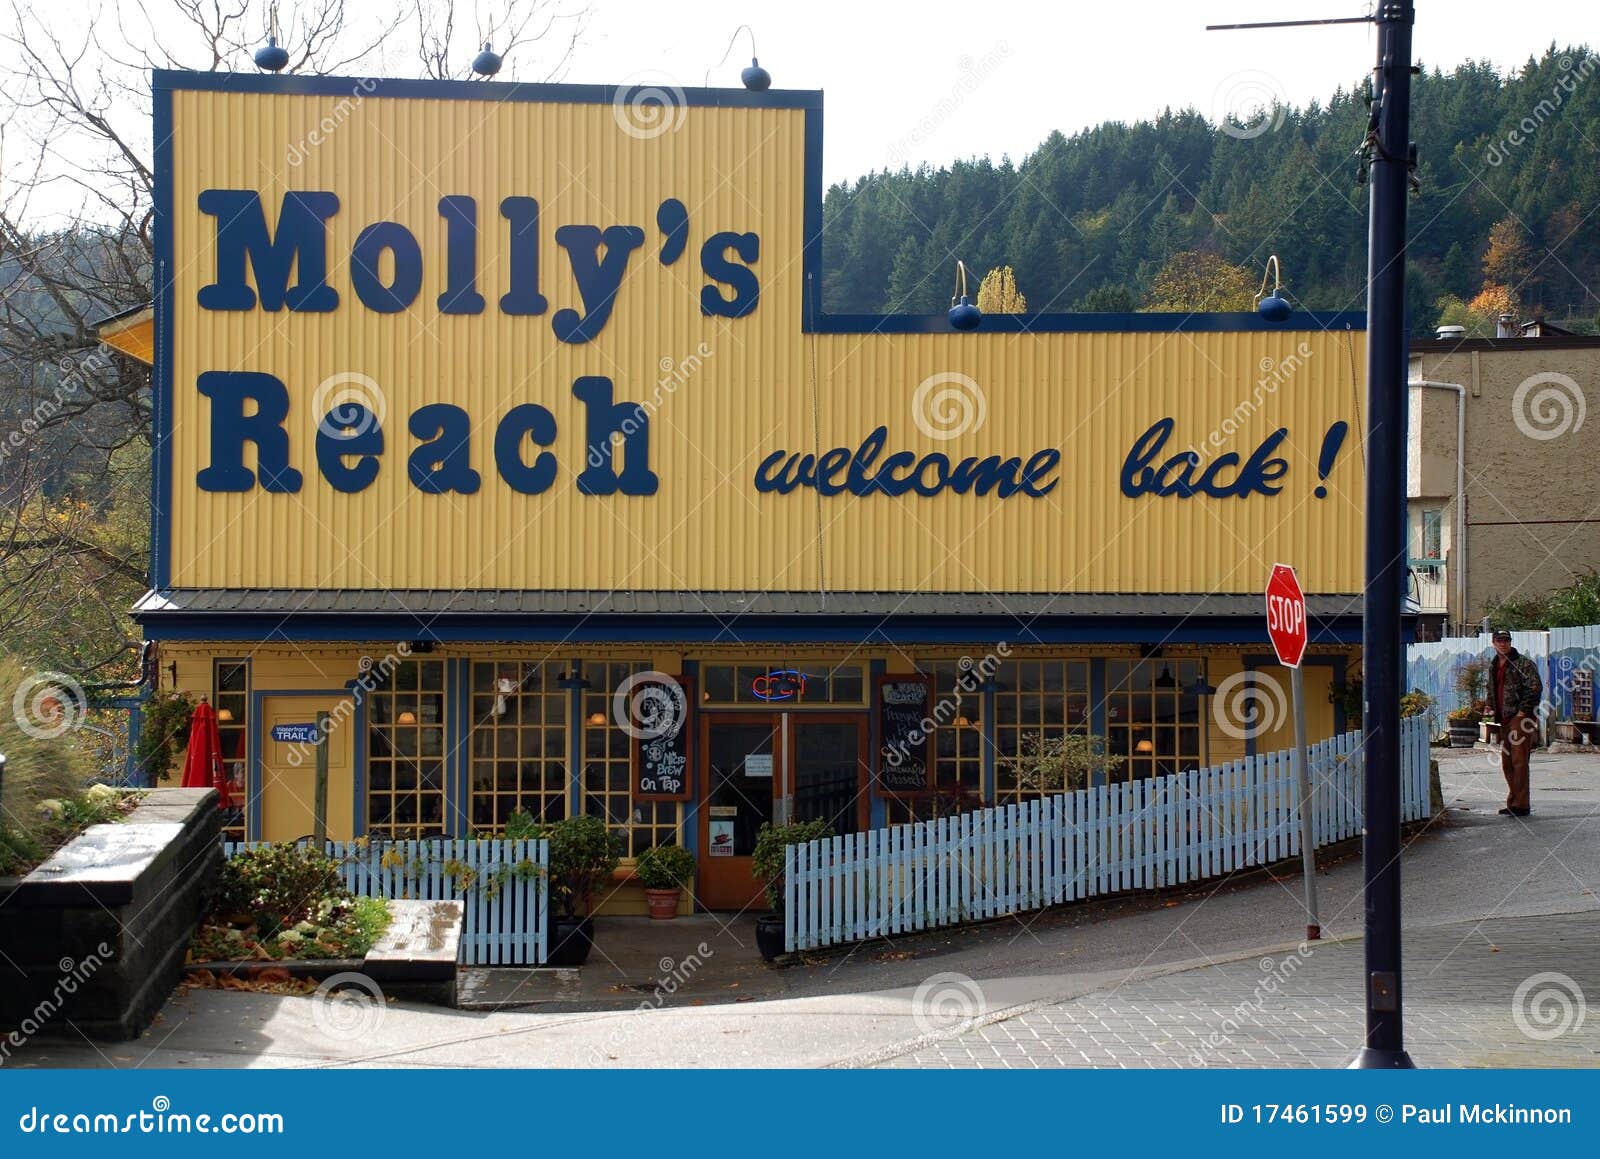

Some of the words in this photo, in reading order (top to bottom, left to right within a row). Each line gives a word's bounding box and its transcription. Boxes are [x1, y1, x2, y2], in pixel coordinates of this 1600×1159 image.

[197, 189, 760, 344] Molly's
[196, 371, 659, 496] Reach
[755, 426, 1061, 498] welcome
[1269, 594, 1302, 635] STOP
[277, 731, 307, 740] TRAIL
[659, 775, 680, 794] Tap
